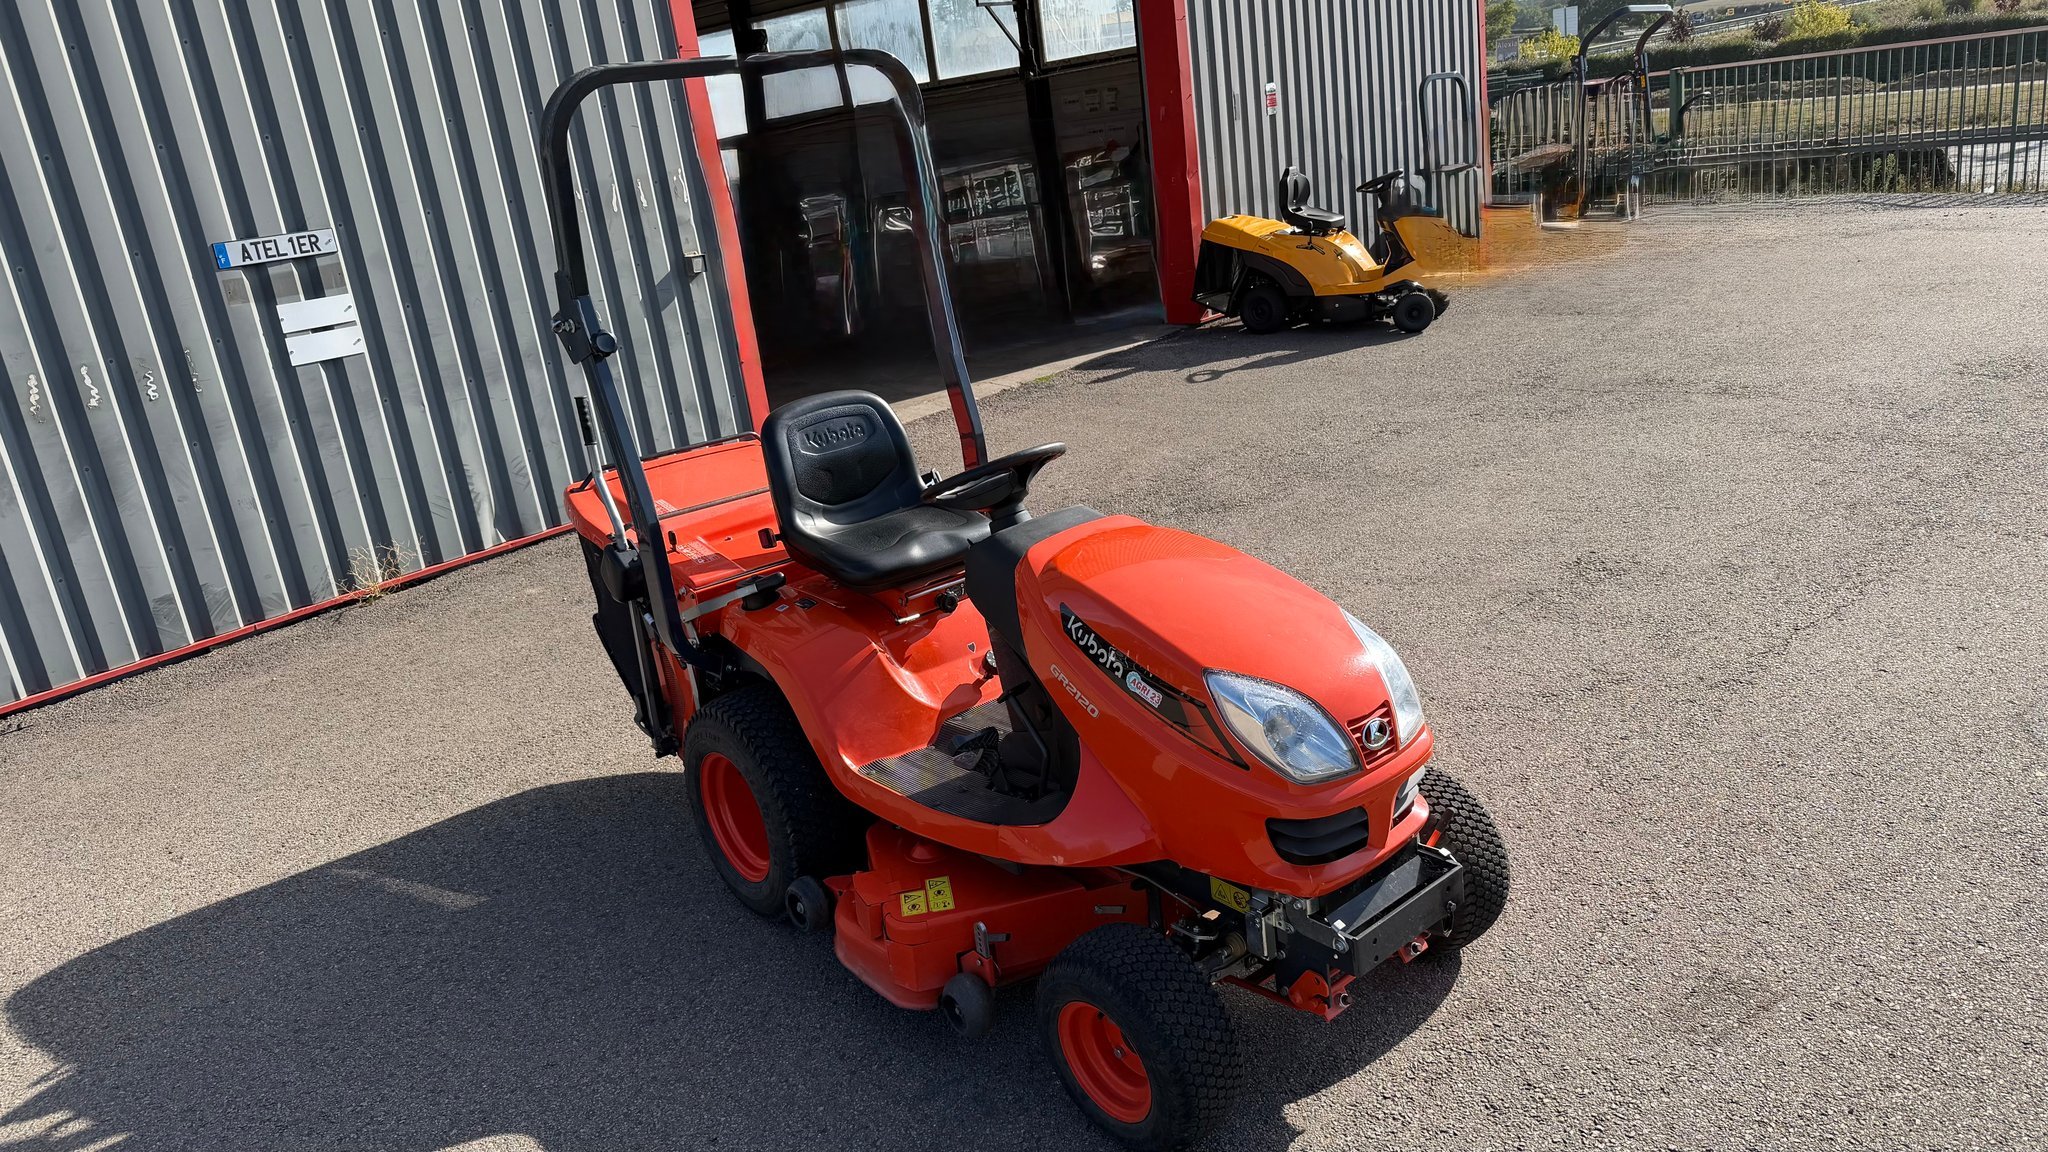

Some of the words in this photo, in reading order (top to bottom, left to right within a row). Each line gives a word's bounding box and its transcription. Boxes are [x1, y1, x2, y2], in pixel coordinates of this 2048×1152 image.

[804, 422, 865, 448] Kubota
[1067, 615, 1124, 679] Kubota
[1050, 663, 1100, 718] GR2120
[1130, 678, 1151, 696] AGRI
